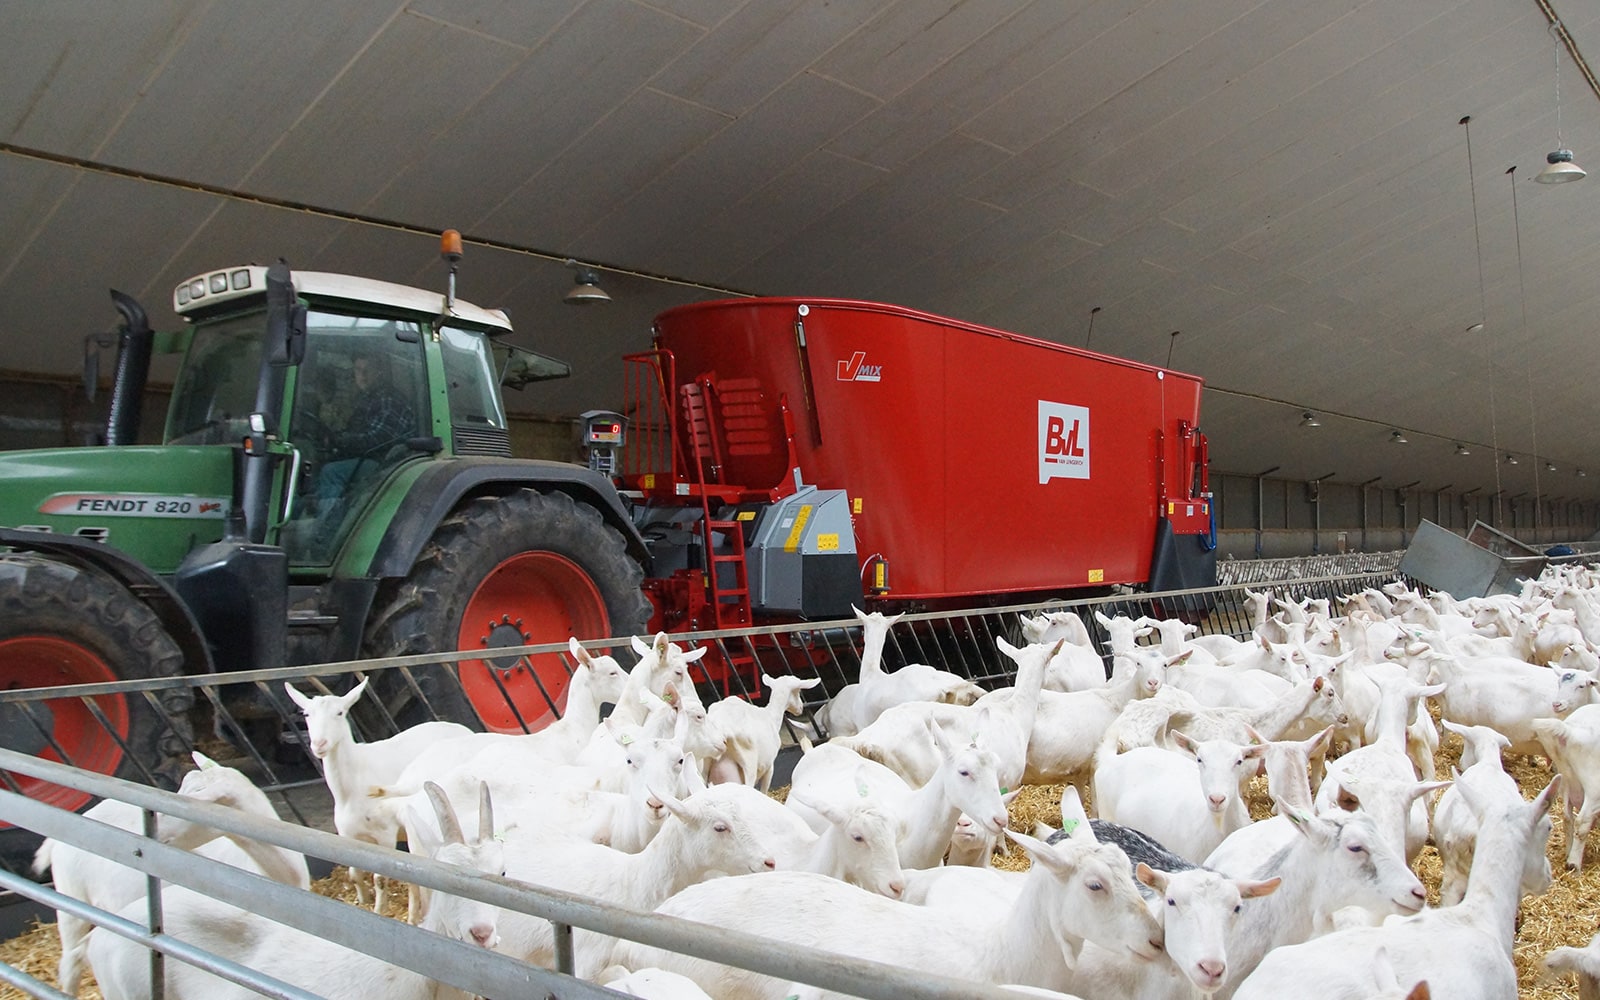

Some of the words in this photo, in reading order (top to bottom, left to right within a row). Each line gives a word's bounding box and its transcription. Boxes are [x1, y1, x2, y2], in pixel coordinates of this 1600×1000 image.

[858, 365, 882, 376] MIX
[77, 499, 147, 512] FENDT
[154, 501, 191, 514] 820
